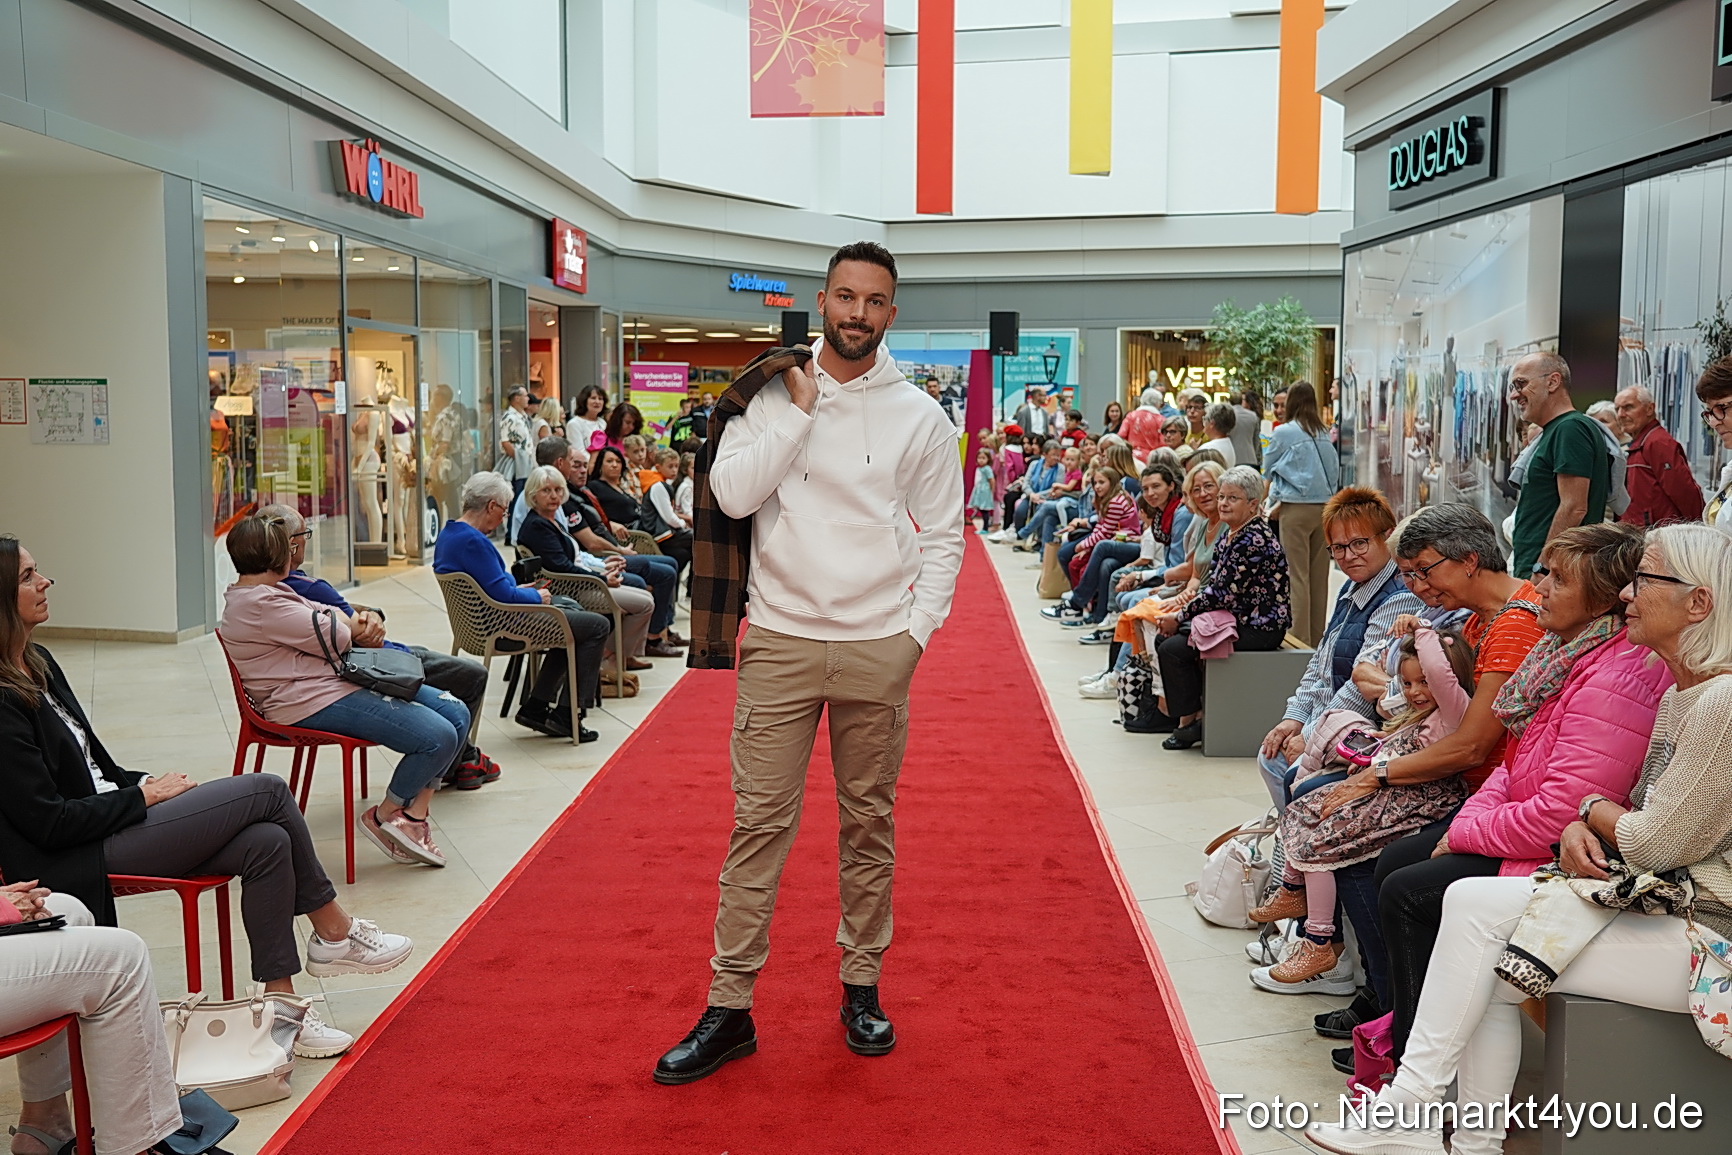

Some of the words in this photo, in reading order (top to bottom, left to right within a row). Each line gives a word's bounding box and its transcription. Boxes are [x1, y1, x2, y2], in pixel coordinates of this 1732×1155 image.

[1388, 115, 1468, 191] DOUGLAS
[340, 138, 424, 219] WÖHRL
[729, 273, 787, 292] Spielwaren
[282, 317, 295, 325] THE
[298, 317, 324, 325] MAKER
[1165, 366, 1237, 388] VER
